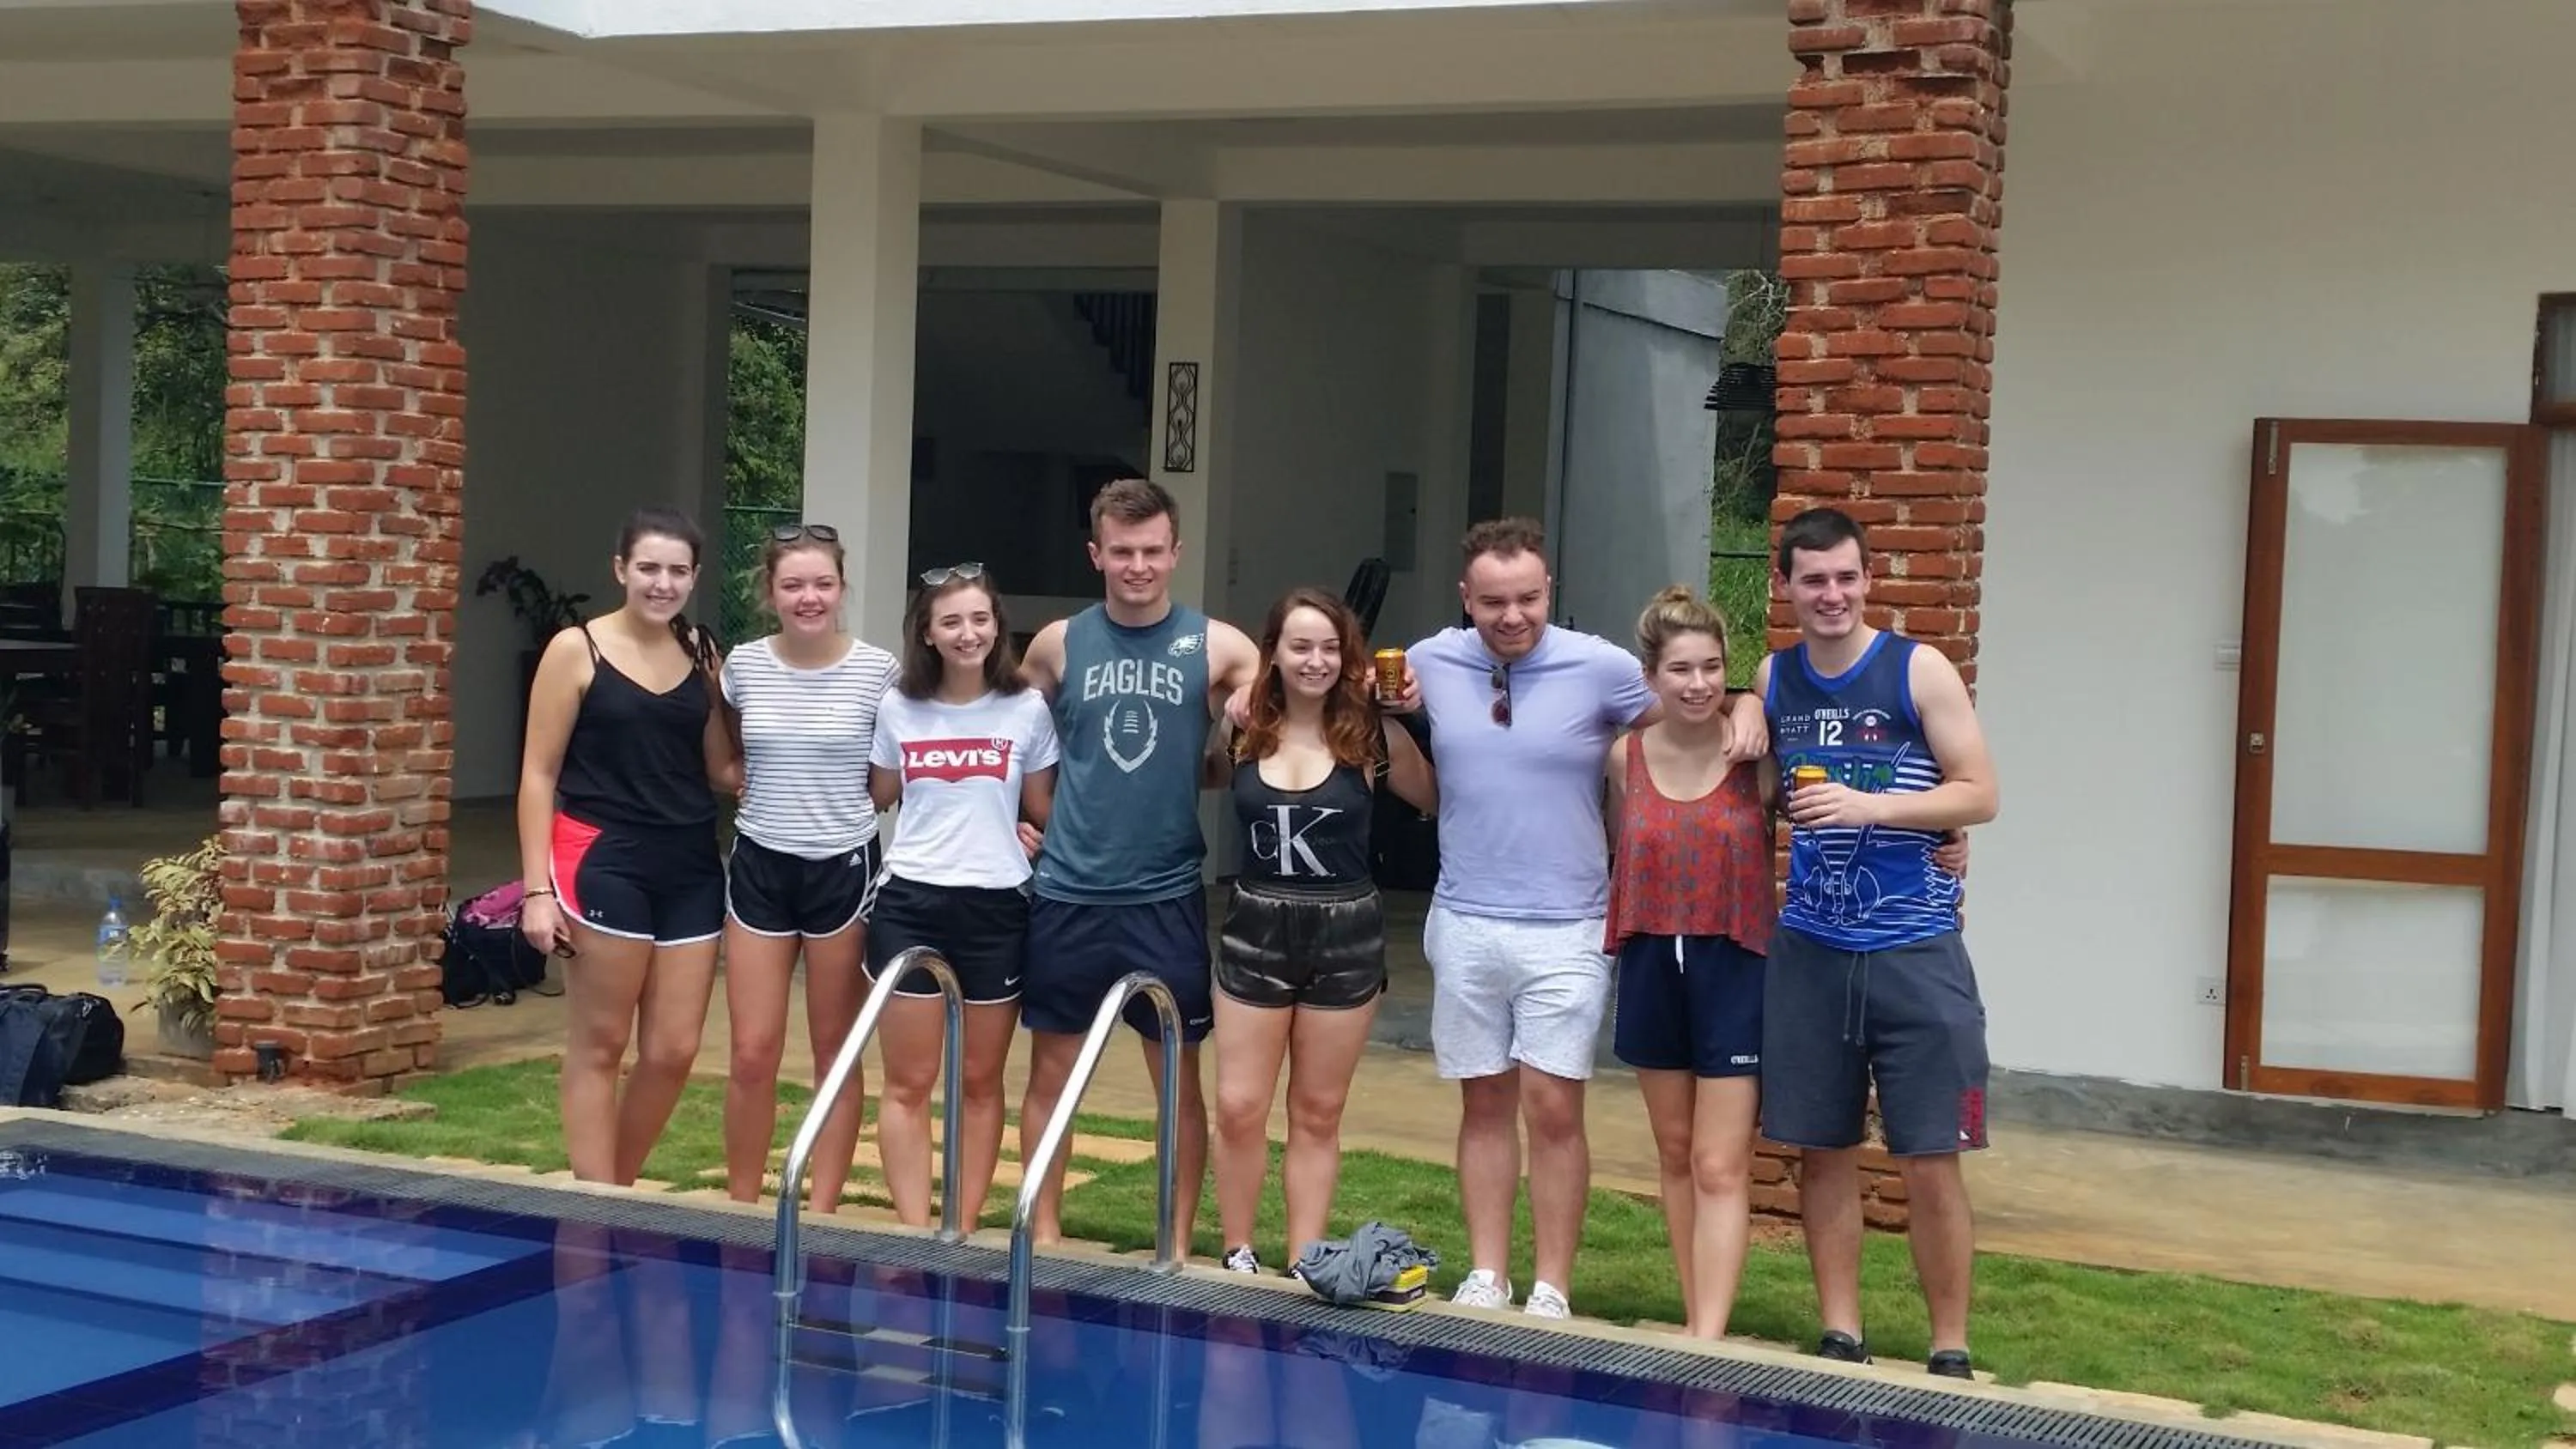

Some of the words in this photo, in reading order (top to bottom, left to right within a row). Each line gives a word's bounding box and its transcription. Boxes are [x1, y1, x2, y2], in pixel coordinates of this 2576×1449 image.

[1083, 658, 1184, 706] EAGLES
[1819, 720, 1844, 746] 12
[1250, 804, 1344, 876] CK
